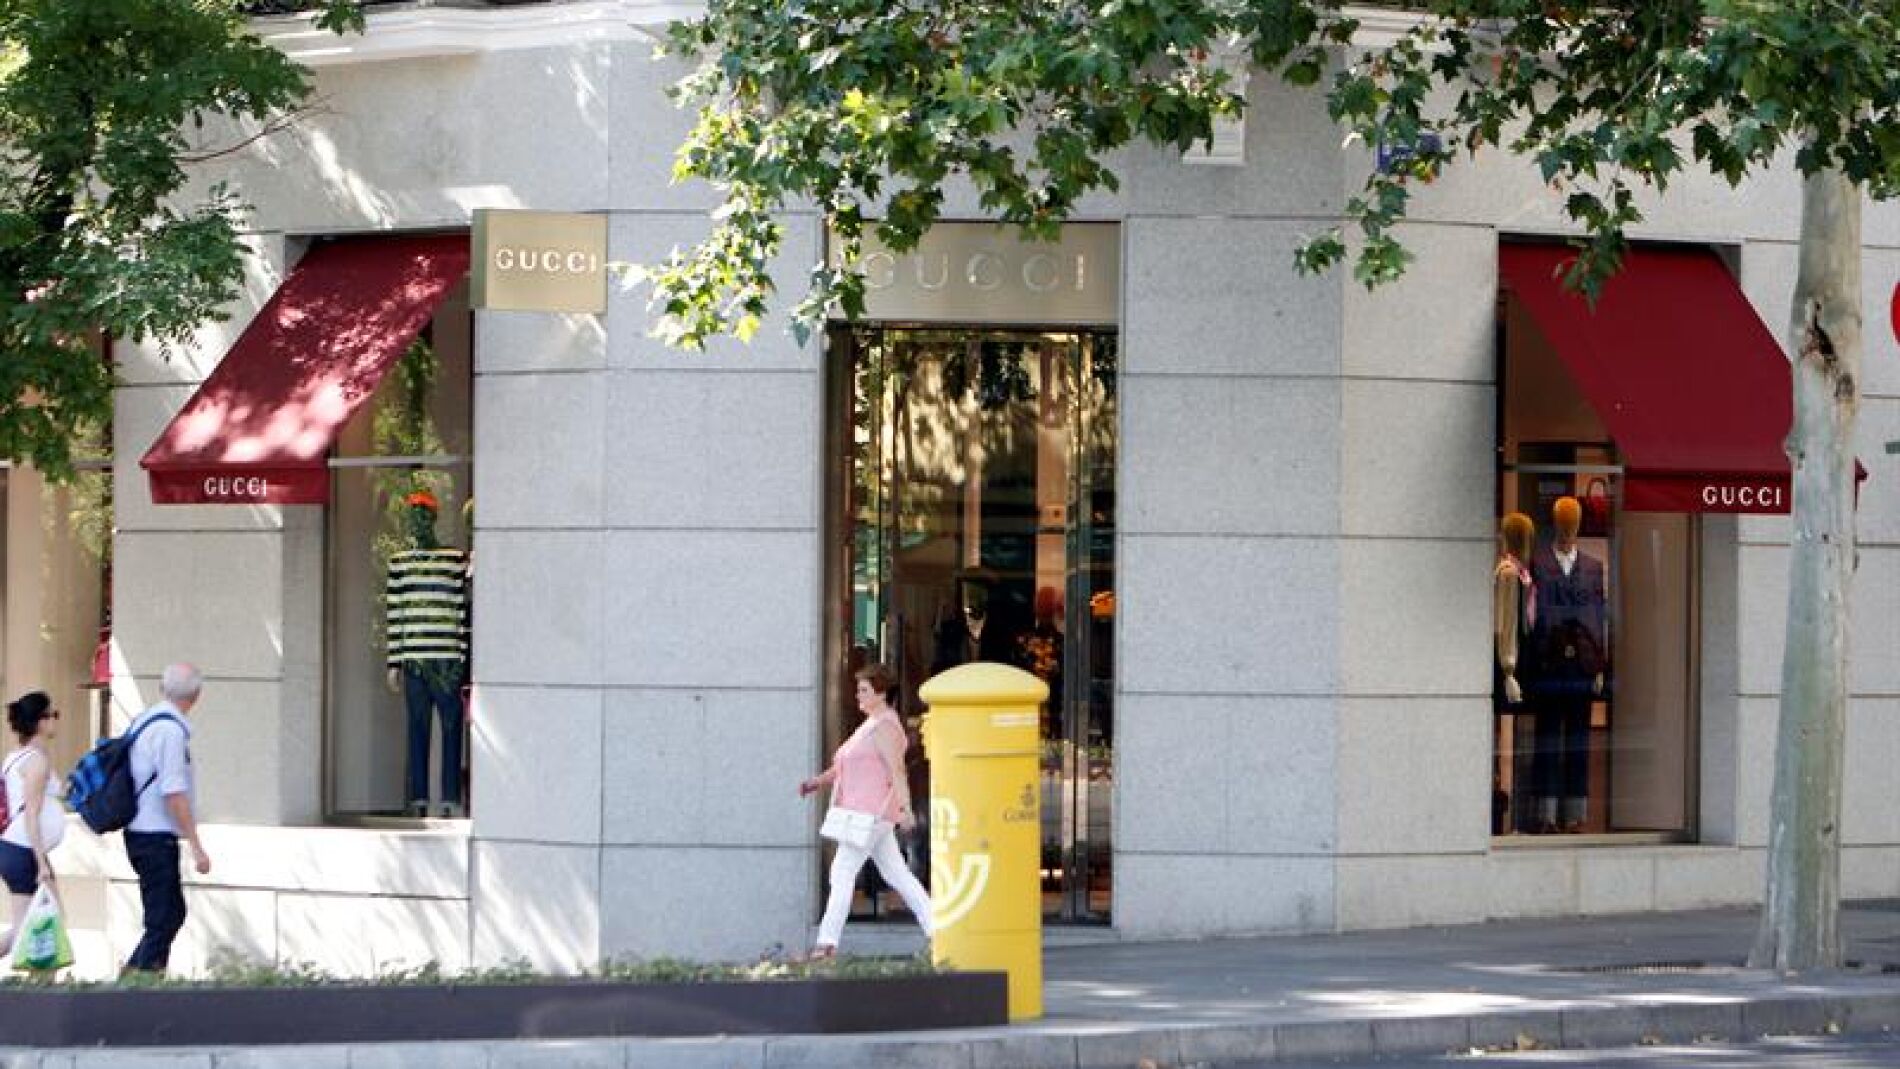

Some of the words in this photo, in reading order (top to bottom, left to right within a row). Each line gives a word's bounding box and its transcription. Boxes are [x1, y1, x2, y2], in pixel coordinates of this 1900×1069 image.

[495, 248, 597, 272] GUCCI
[203, 476, 267, 497] GUCCI
[1702, 485, 1782, 506] GUCCI
